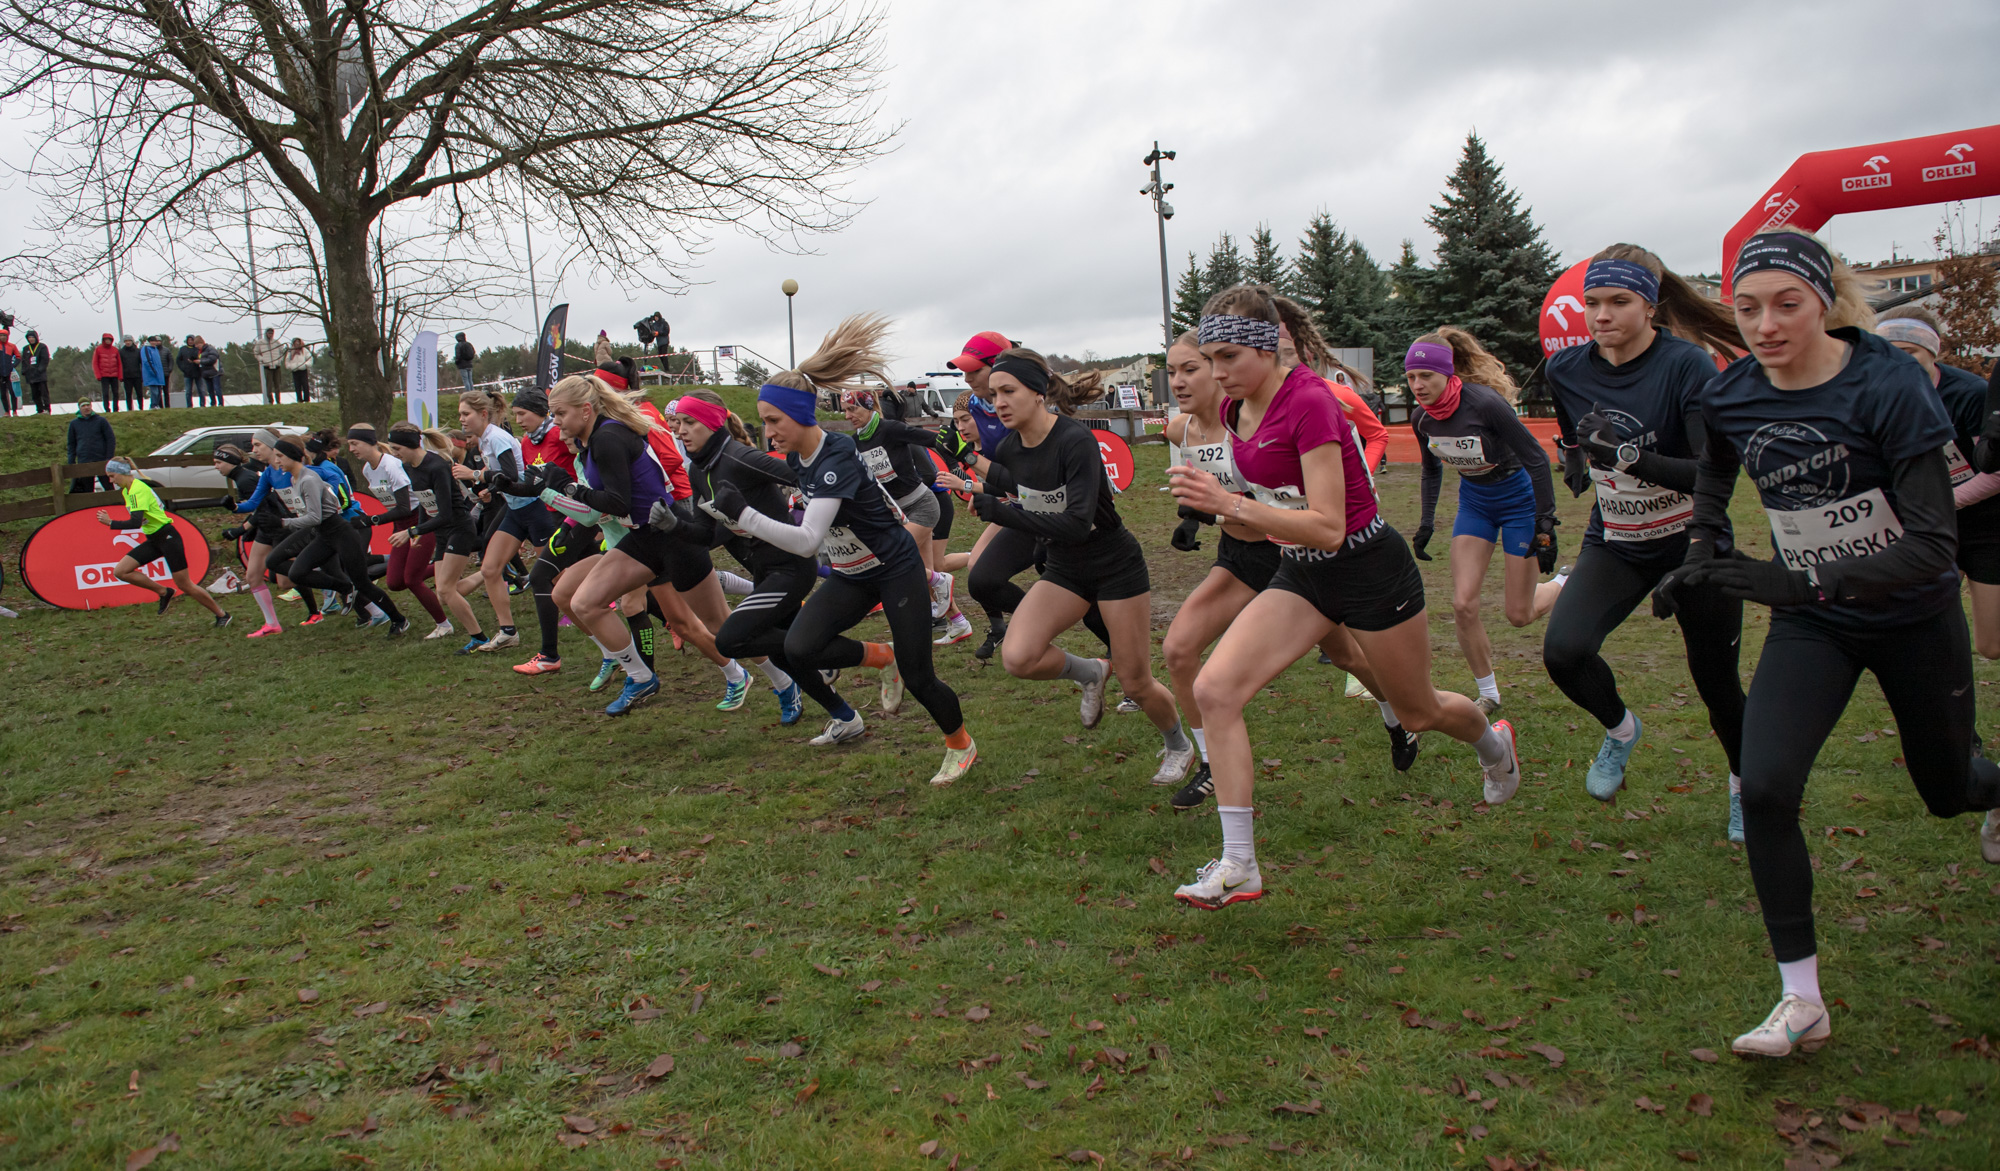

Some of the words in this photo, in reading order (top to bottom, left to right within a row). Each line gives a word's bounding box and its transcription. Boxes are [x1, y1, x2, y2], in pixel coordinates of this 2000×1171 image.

[1925, 164, 1973, 180] ORLEN
[1845, 175, 1889, 190] ORLEN
[415, 346, 423, 393] Lubuskie
[1455, 439, 1475, 450] 457
[870, 447, 884, 459] 526
[1197, 446, 1224, 462] 292
[1759, 443, 1850, 490] ONDYCJA
[1041, 491, 1065, 504] 389
[1599, 490, 1689, 516] PARADOWSKA
[1823, 499, 1874, 529] 209
[1611, 530, 1643, 539] ZIELONA
[1643, 527, 1670, 538] GÓRA
[1783, 527, 1901, 568] PŁOCIŃSKA
